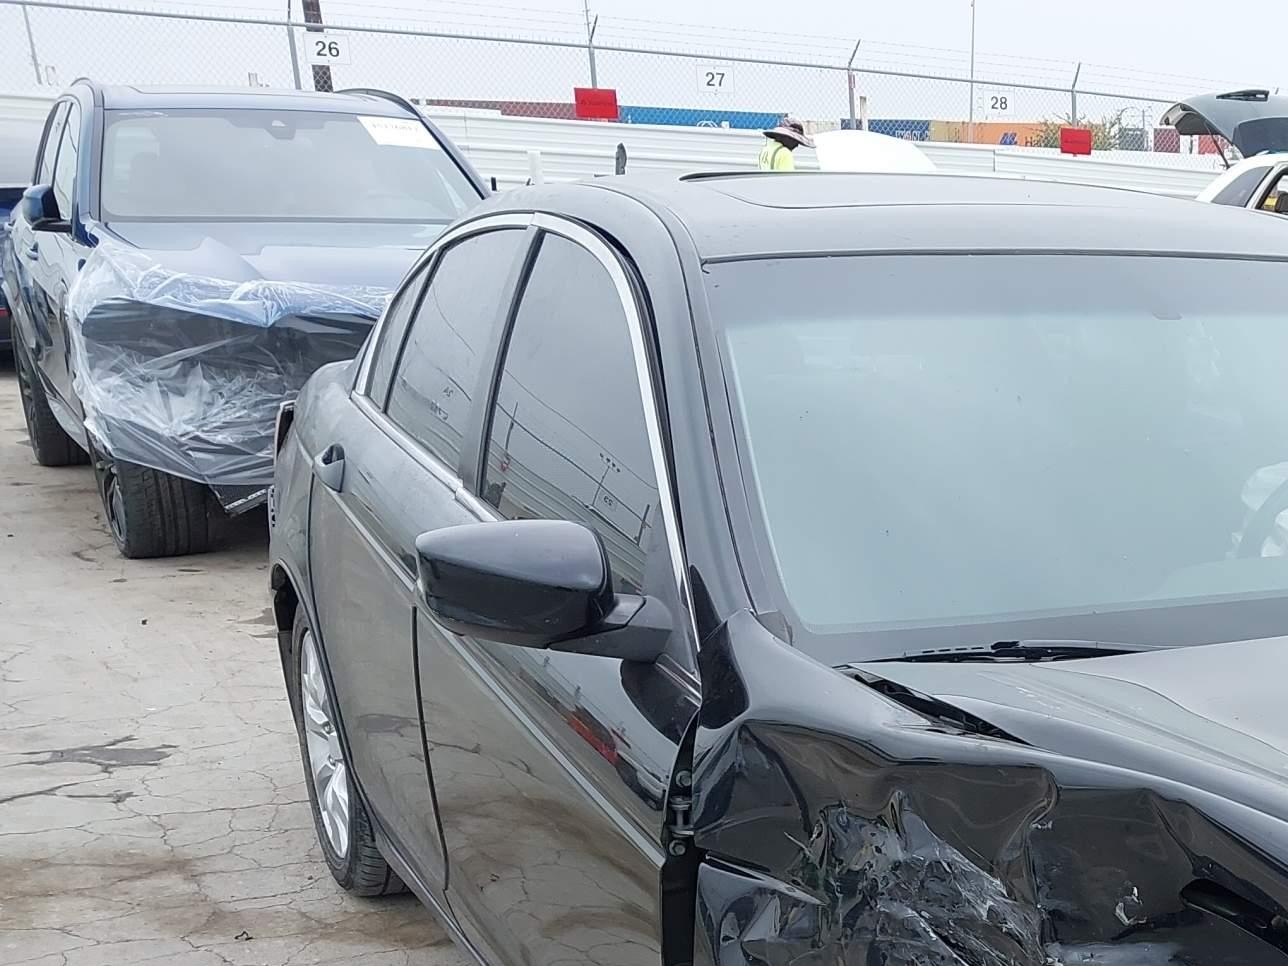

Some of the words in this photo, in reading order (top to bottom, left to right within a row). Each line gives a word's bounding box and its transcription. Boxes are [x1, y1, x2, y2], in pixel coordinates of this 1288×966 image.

[315, 40, 340, 57] 26
[705, 71, 725, 87] 27
[990, 95, 1008, 110] 28
